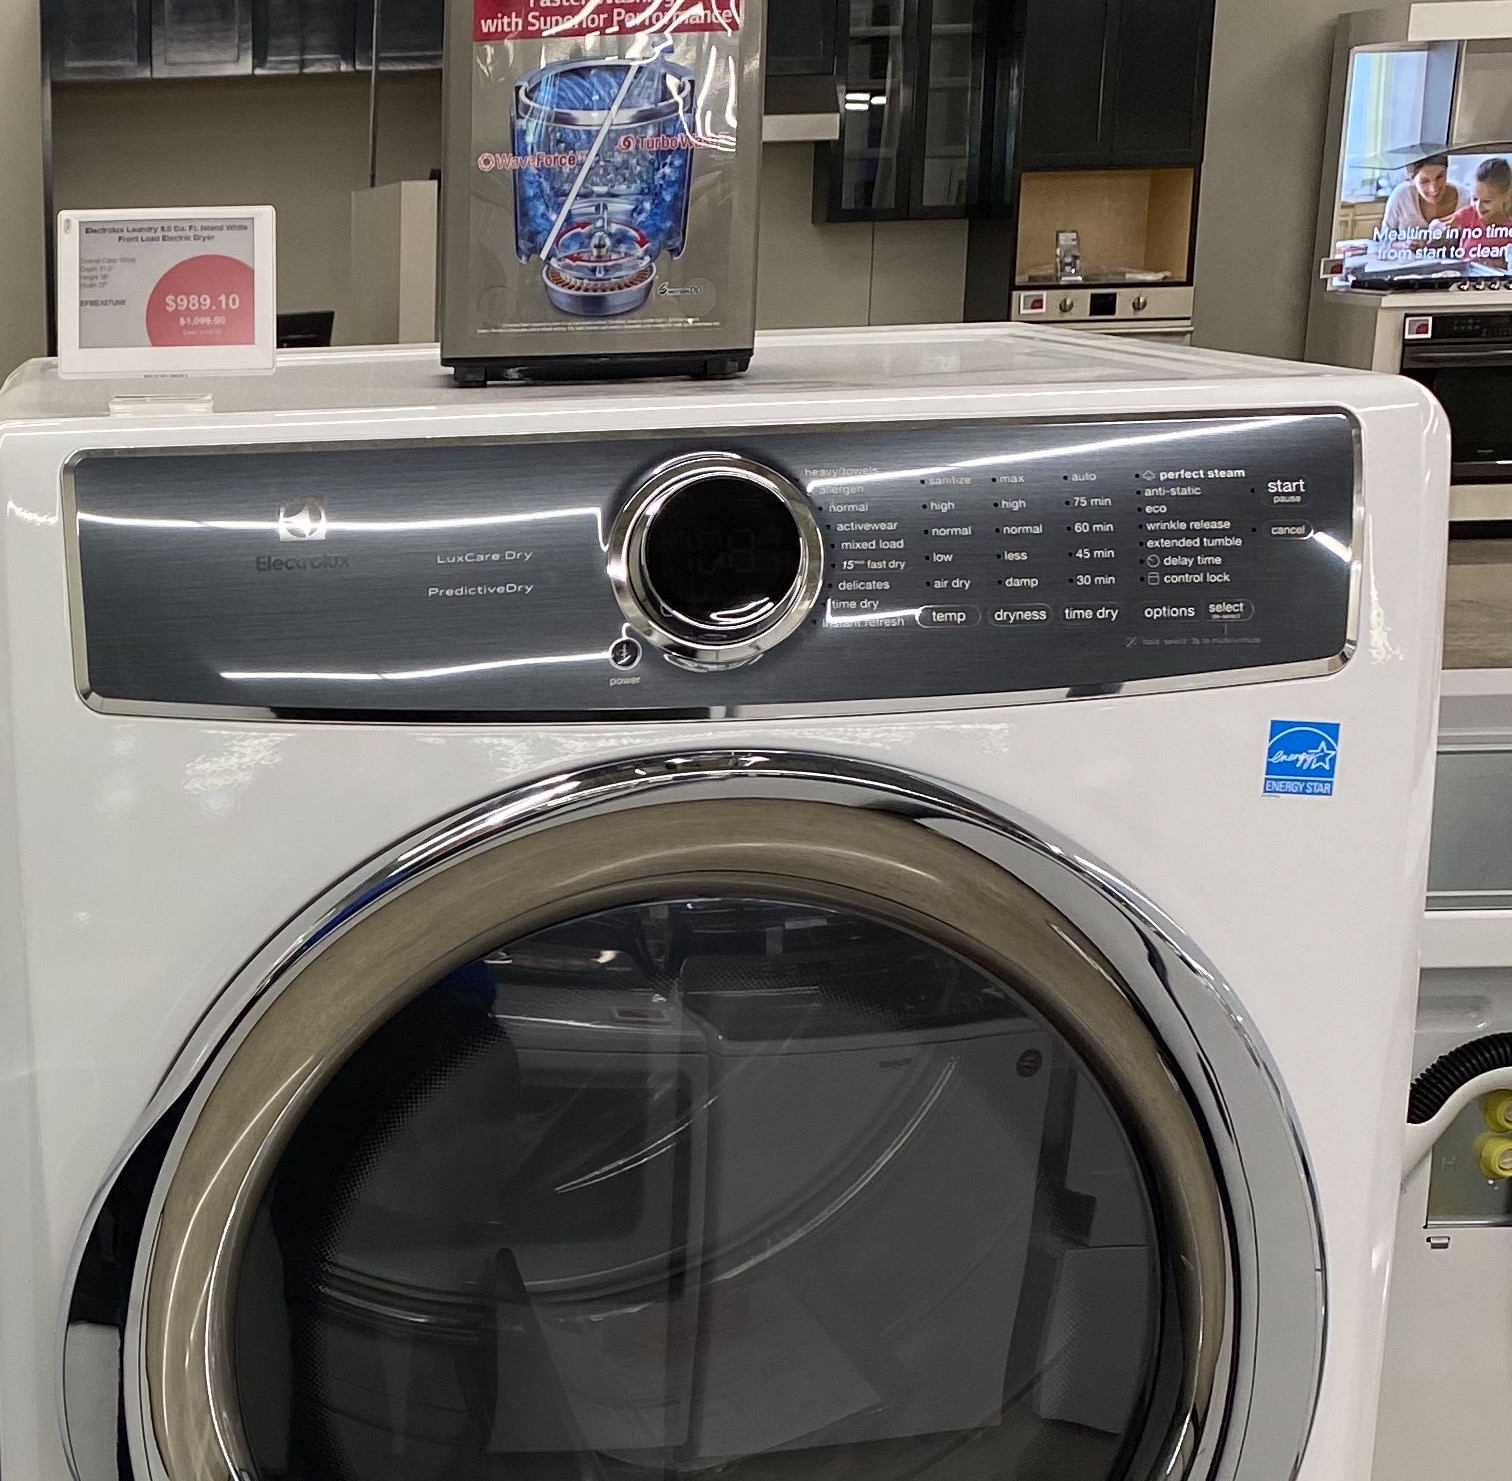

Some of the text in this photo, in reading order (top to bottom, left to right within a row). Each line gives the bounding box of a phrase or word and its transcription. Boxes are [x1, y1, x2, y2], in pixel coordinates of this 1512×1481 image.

[480, 15, 523, 33] with
[639, 133, 719, 150] TurboW
[193, 234, 215, 242] Dryer
[1373, 226, 1442, 242] Mealtime
[1446, 226, 1459, 239] in
[1461, 228, 1482, 240] no
[1378, 246, 1411, 260] from
[1415, 246, 1446, 259] start
[1450, 245, 1465, 258] to
[165, 293, 240, 312] $989.10
[179, 315, 226, 326] $1,099.00
[804, 466, 879, 477] heavy/towels
[1071, 472, 1097, 482] auto
[1159, 468, 1246, 481] perfect steam
[928, 475, 972, 486] sanitize
[999, 475, 1025, 484] max
[1144, 485, 1202, 497] anti-static
[1267, 479, 1305, 493] start
[1001, 499, 1027, 511] high
[1073, 496, 1112, 507] 75 min
[1273, 494, 1301, 504] pause
[829, 502, 869, 513] normal
[930, 501, 955, 513] high
[1145, 504, 1167, 514] eco
[836, 521, 898, 532] activewear
[931, 525, 972, 536] normal
[1003, 523, 1043, 535] normal
[1074, 522, 1114, 533] 60 min
[1146, 519, 1231, 531] wrinkle release
[1271, 525, 1305, 535] cancel
[840, 538, 904, 550] mixed load
[1146, 536, 1242, 548] extended tumble
[436, 549, 533, 565] LuxCare Dry
[933, 552, 953, 562] low
[1004, 550, 1028, 561] less
[1075, 548, 1115, 559] 45 min
[867, 558, 906, 570] fast dry
[1163, 555, 1222, 567] delay time
[933, 578, 971, 590] air dry
[1005, 576, 1039, 589] damp
[1076, 574, 1116, 586] 30 min
[1163, 572, 1230, 584] control lock
[428, 583, 534, 598] PredictiveDry
[838, 579, 890, 591] delicates
[831, 598, 880, 611] time dry
[1208, 601, 1244, 613] select
[932, 611, 966, 624] temp
[994, 609, 1047, 624] dryness
[1064, 606, 1119, 621] time dry
[1144, 606, 1195, 620] options
[609, 675, 641, 687] power
[1265, 780, 1331, 794] ENERGY STAR
